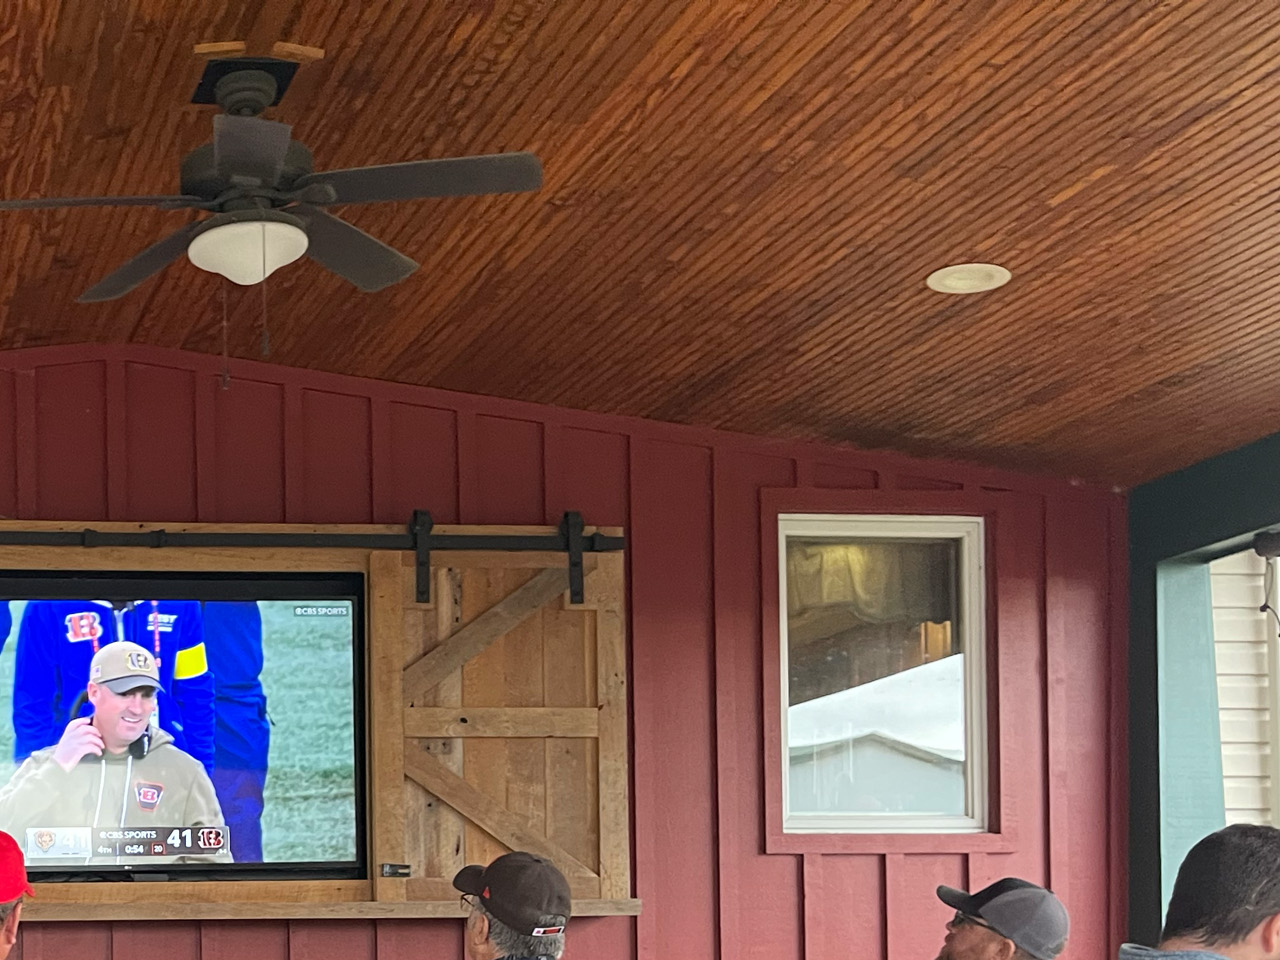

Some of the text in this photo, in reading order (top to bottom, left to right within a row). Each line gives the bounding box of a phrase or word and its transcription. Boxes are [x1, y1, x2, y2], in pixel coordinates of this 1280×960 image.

[318, 607, 347, 616] SPORTS
[124, 830, 157, 839] SPORTS
[167, 828, 192, 848] 41
[125, 845, 144, 855] 0:54
